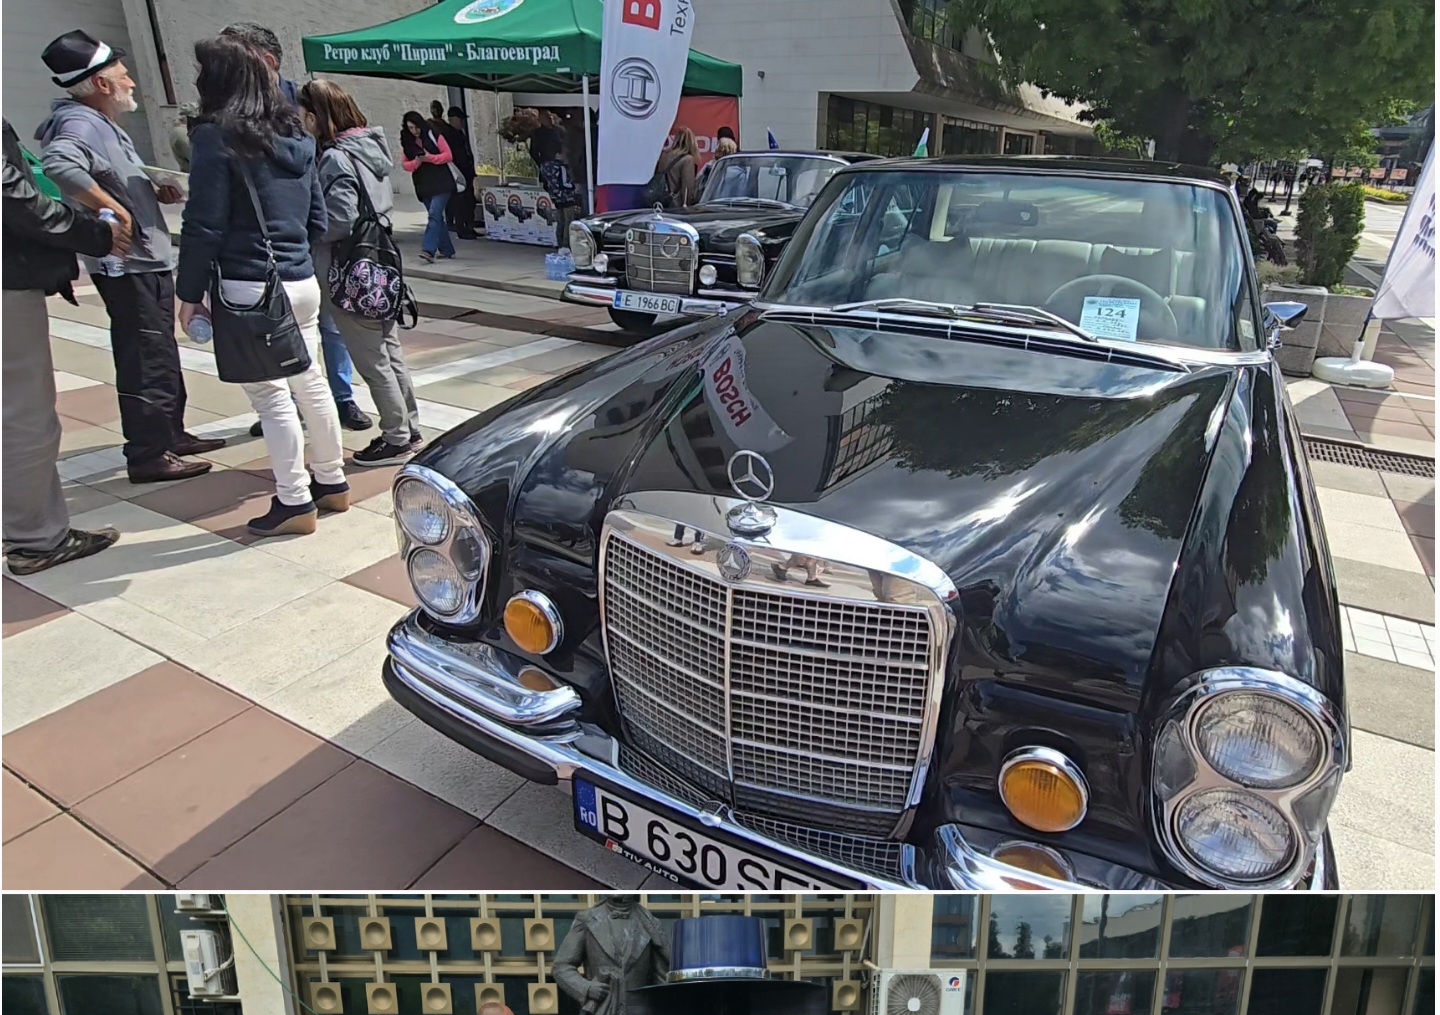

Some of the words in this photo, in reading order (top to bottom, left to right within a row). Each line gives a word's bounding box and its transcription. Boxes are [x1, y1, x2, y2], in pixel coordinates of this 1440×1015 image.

[323, 43, 358, 65] Ретро
[361, 43, 390, 65] клуб
[393, 43, 453, 66] "Пирин"
[465, 43, 560, 66] Благоевград
[625, 294, 633, 307] E
[637, 296, 659, 310] 1966
[1097, 307, 1126, 318] 124
[580, 806, 596, 827] RO
[601, 795, 630, 841] B
[647, 820, 727, 886] 630
[644, 862, 679, 882] AUTO
